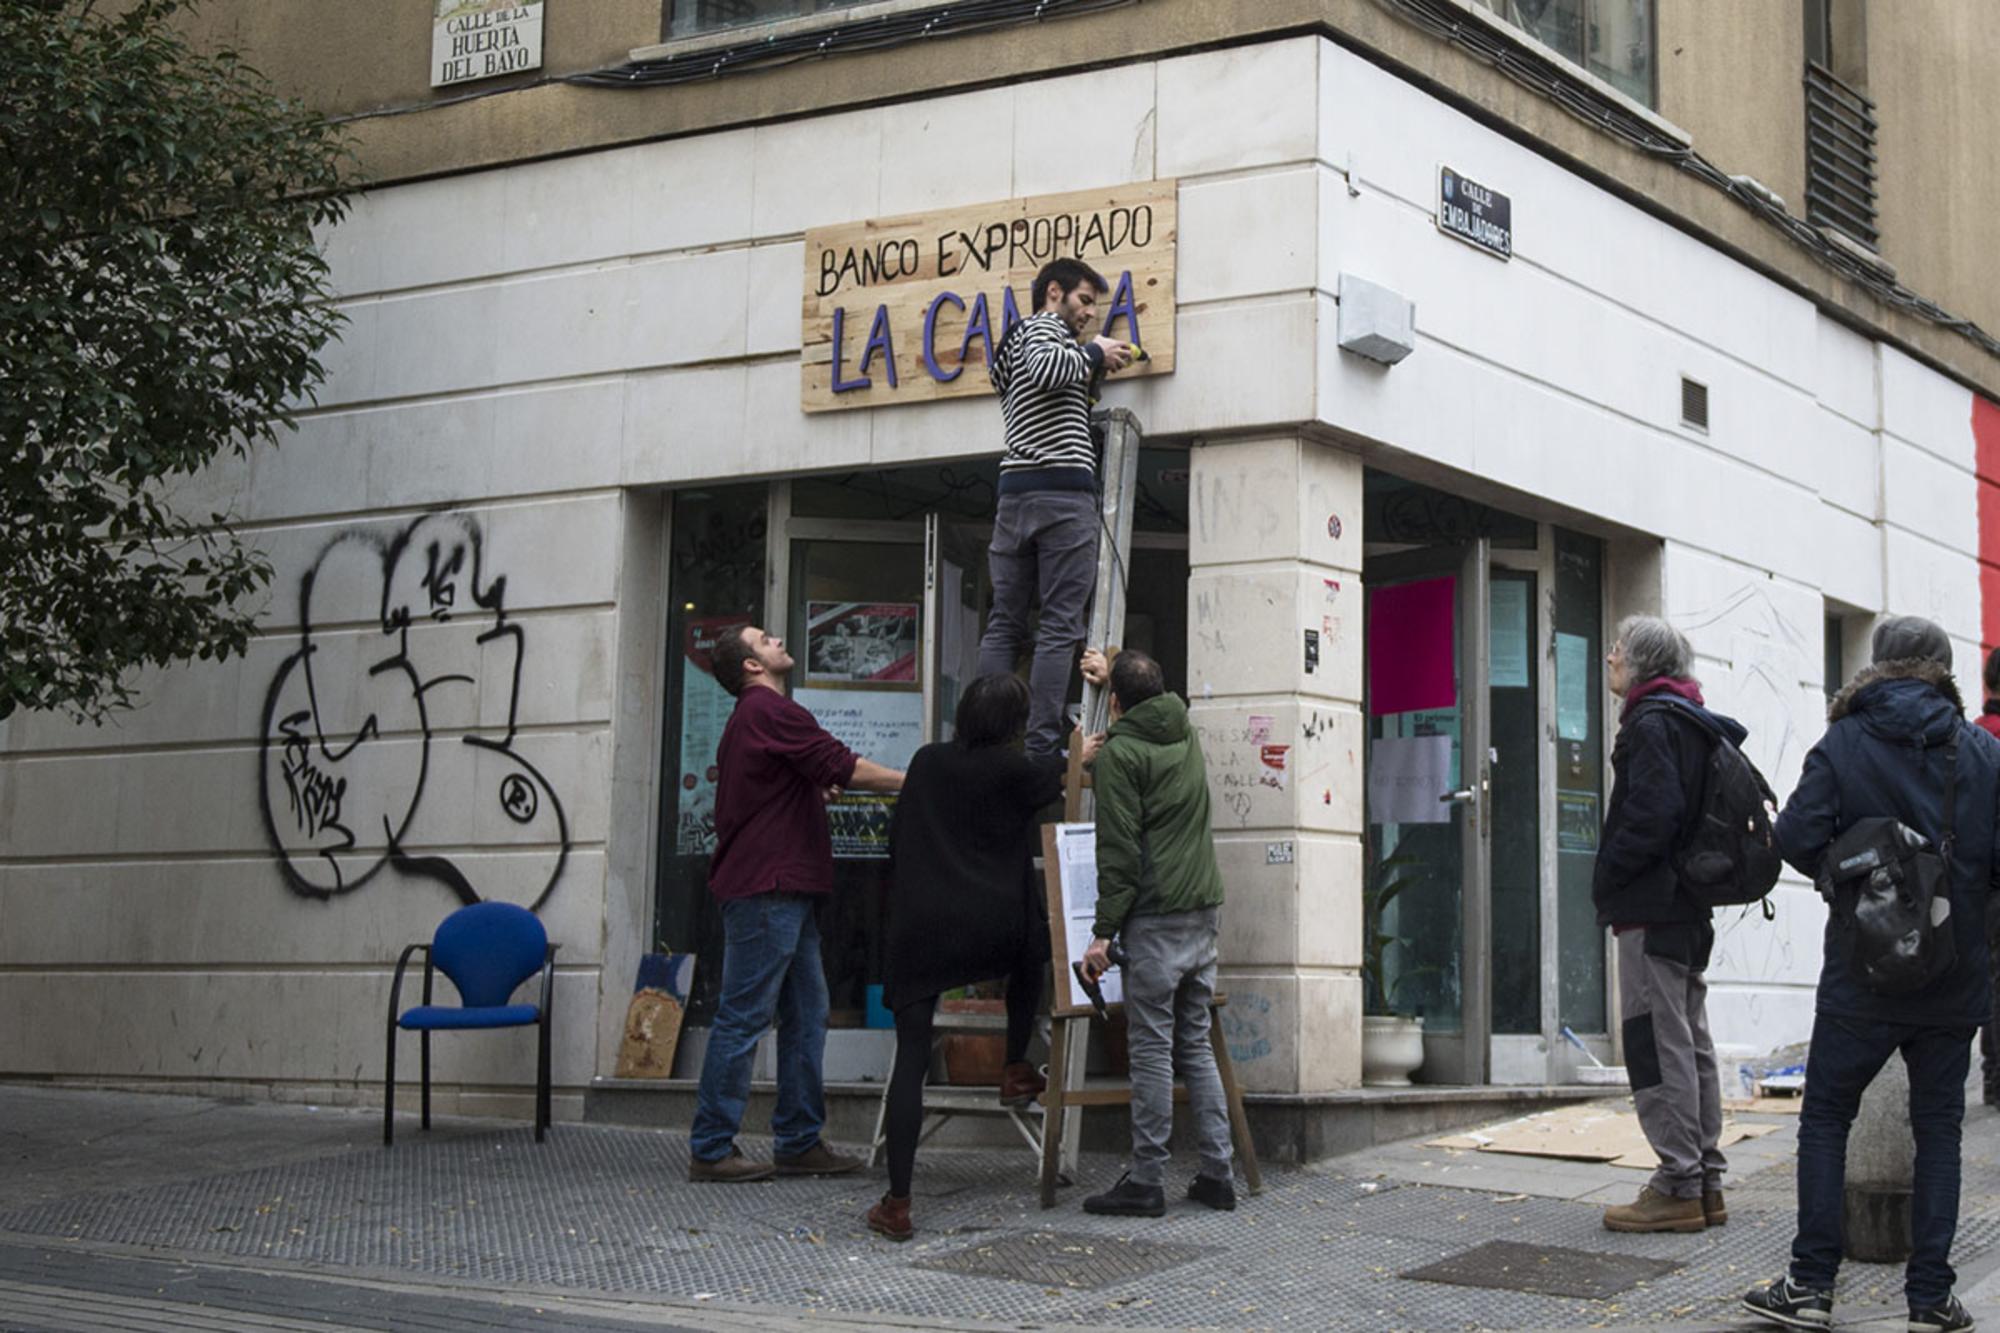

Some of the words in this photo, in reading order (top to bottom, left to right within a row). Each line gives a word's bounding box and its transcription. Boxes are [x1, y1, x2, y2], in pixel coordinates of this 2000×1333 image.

[446, 13, 492, 35] CALLE
[496, 12, 510, 23] DE
[514, 8, 528, 19] LA
[452, 26, 520, 58] HUERTA
[442, 57, 478, 82] DEL
[485, 47, 529, 75] BAYO
[1462, 181, 1492, 207] CALLE
[815, 237, 919, 297] BANCO
[832, 303, 898, 393] LA
